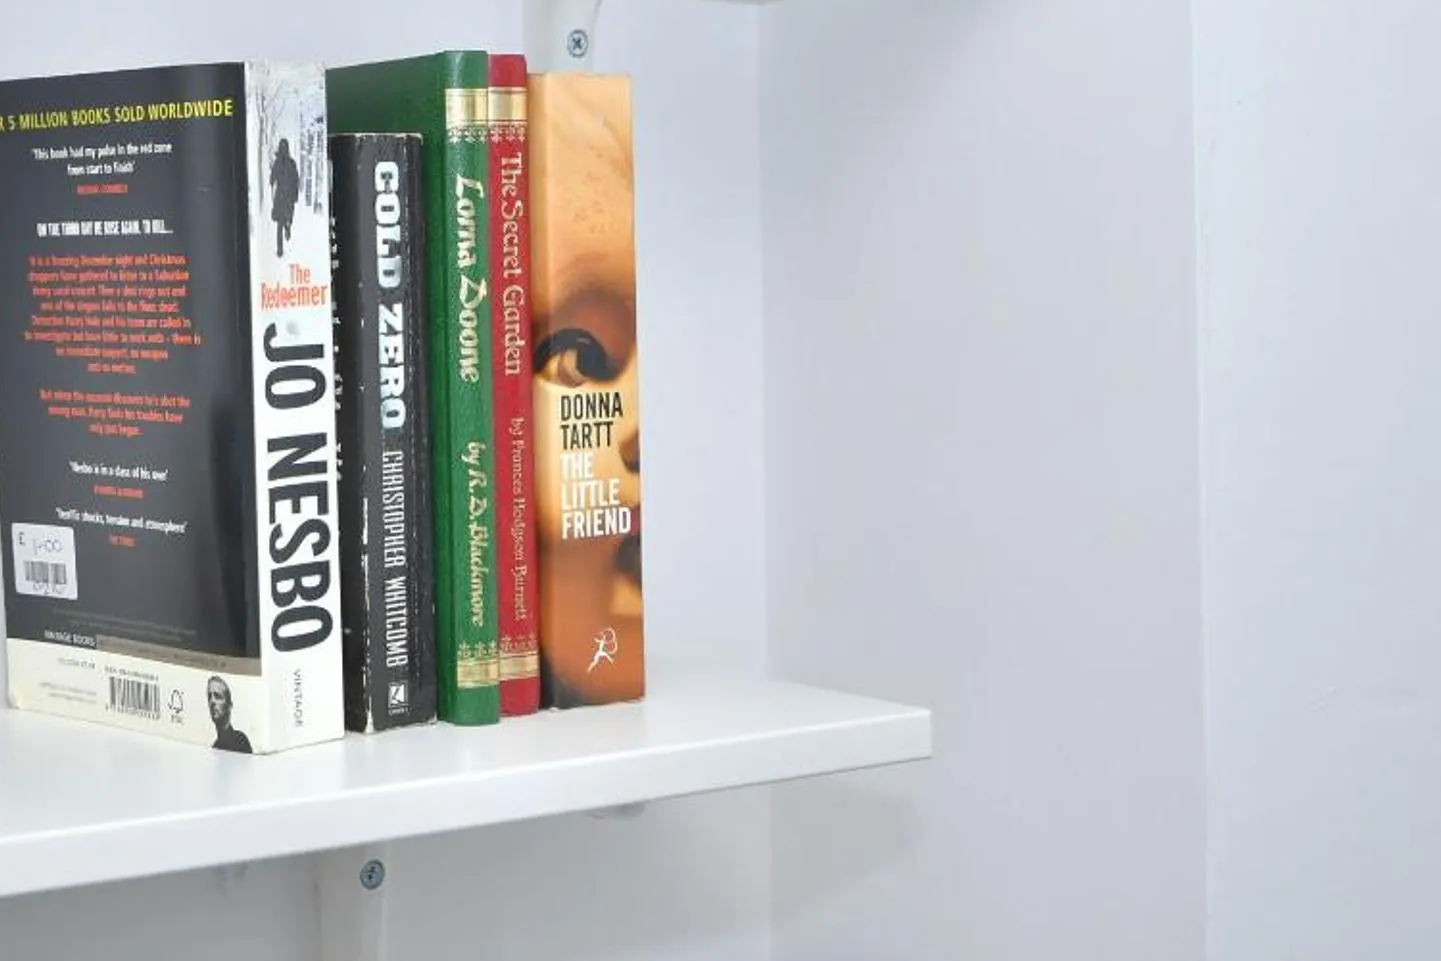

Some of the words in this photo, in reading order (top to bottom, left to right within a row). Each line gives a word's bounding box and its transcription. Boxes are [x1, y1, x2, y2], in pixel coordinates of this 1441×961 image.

[7, 115, 17, 132] 5
[19, 111, 69, 131] MILLION
[71, 108, 112, 128] BOOKS
[114, 105, 145, 124] SOLD
[147, 99, 234, 122] WORLDWIDE
[103, 162, 113, 175] to
[126, 142, 139, 155] the
[500, 152, 523, 197] The
[374, 160, 402, 288] COLD
[455, 174, 485, 268] Lorna
[500, 201, 524, 280] Secret
[260, 282, 329, 312] Redeemer
[288, 263, 311, 284] The
[459, 276, 489, 384] Doone
[502, 284, 525, 376] Garden
[262, 322, 327, 411] JO
[378, 303, 406, 429] ZERO
[508, 417, 525, 437] by
[559, 391, 624, 420] DONNA
[461, 441, 486, 466] by
[559, 421, 614, 451] TARTT
[468, 469, 488, 494] R.
[511, 439, 526, 494] Frances
[559, 450, 594, 481] THE
[381, 450, 408, 569] CHRISTOPHER
[468, 495, 488, 521] D.
[560, 478, 621, 508] LITTLE
[267, 431, 334, 653] NESBO
[511, 497, 527, 561] Hodgson
[561, 506, 632, 540] FRIEND
[468, 523, 489, 628] Blackmore
[511, 564, 528, 621] Burnett
[383, 576, 409, 670] WHITCOMB
[293, 668, 304, 727] VINTAGE
